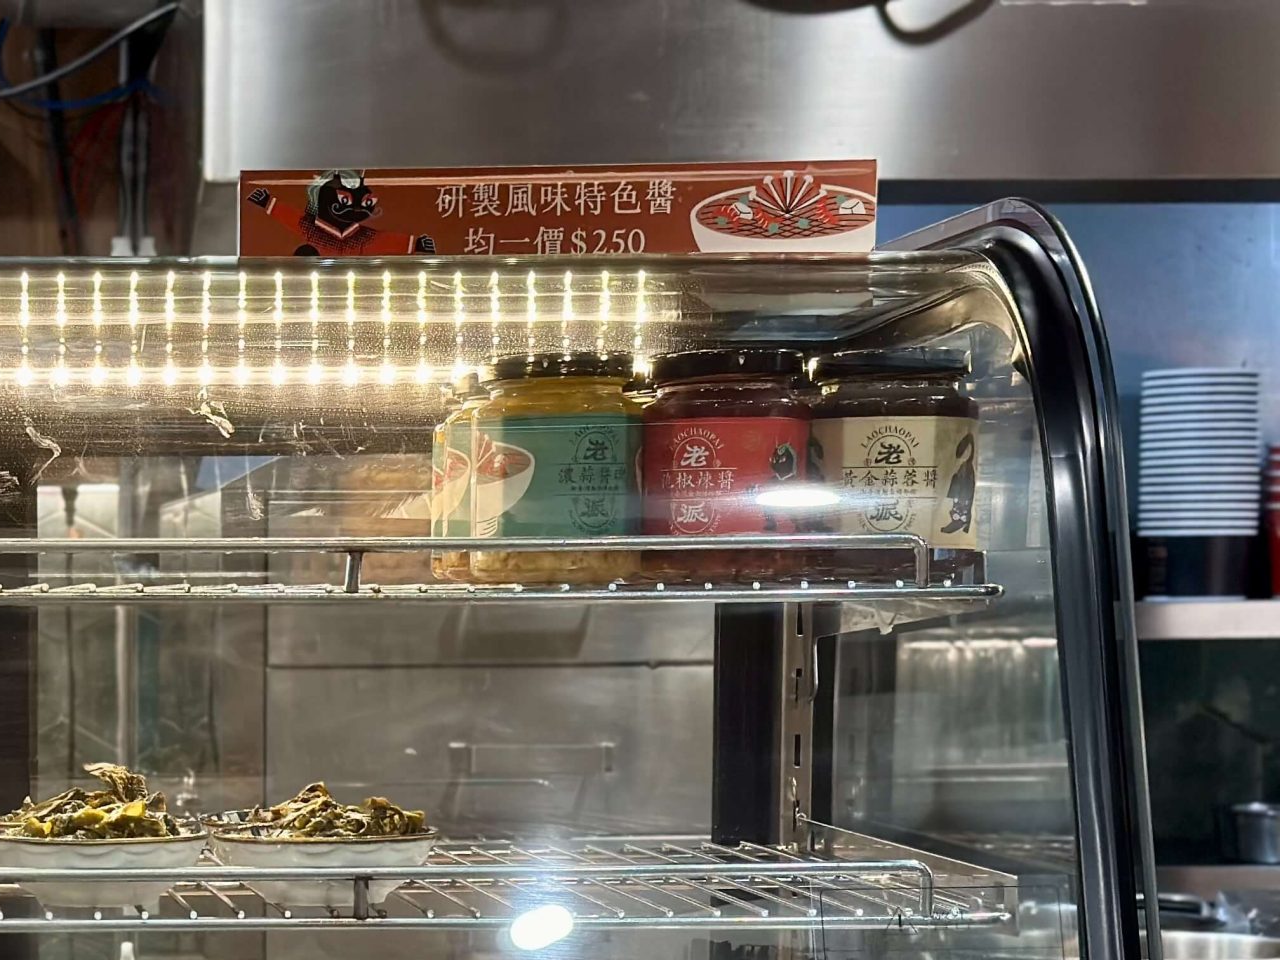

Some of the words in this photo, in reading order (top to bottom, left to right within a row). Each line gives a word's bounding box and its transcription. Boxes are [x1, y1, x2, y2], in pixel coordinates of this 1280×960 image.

[435, 178, 678, 217] 研製風味特色醬
[464, 226, 646, 254] 均一價$250
[861, 425, 920, 449] LAOCHAOPAI
[680, 444, 709, 467] 老
[875, 441, 904, 465] 老
[677, 502, 708, 524] 派
